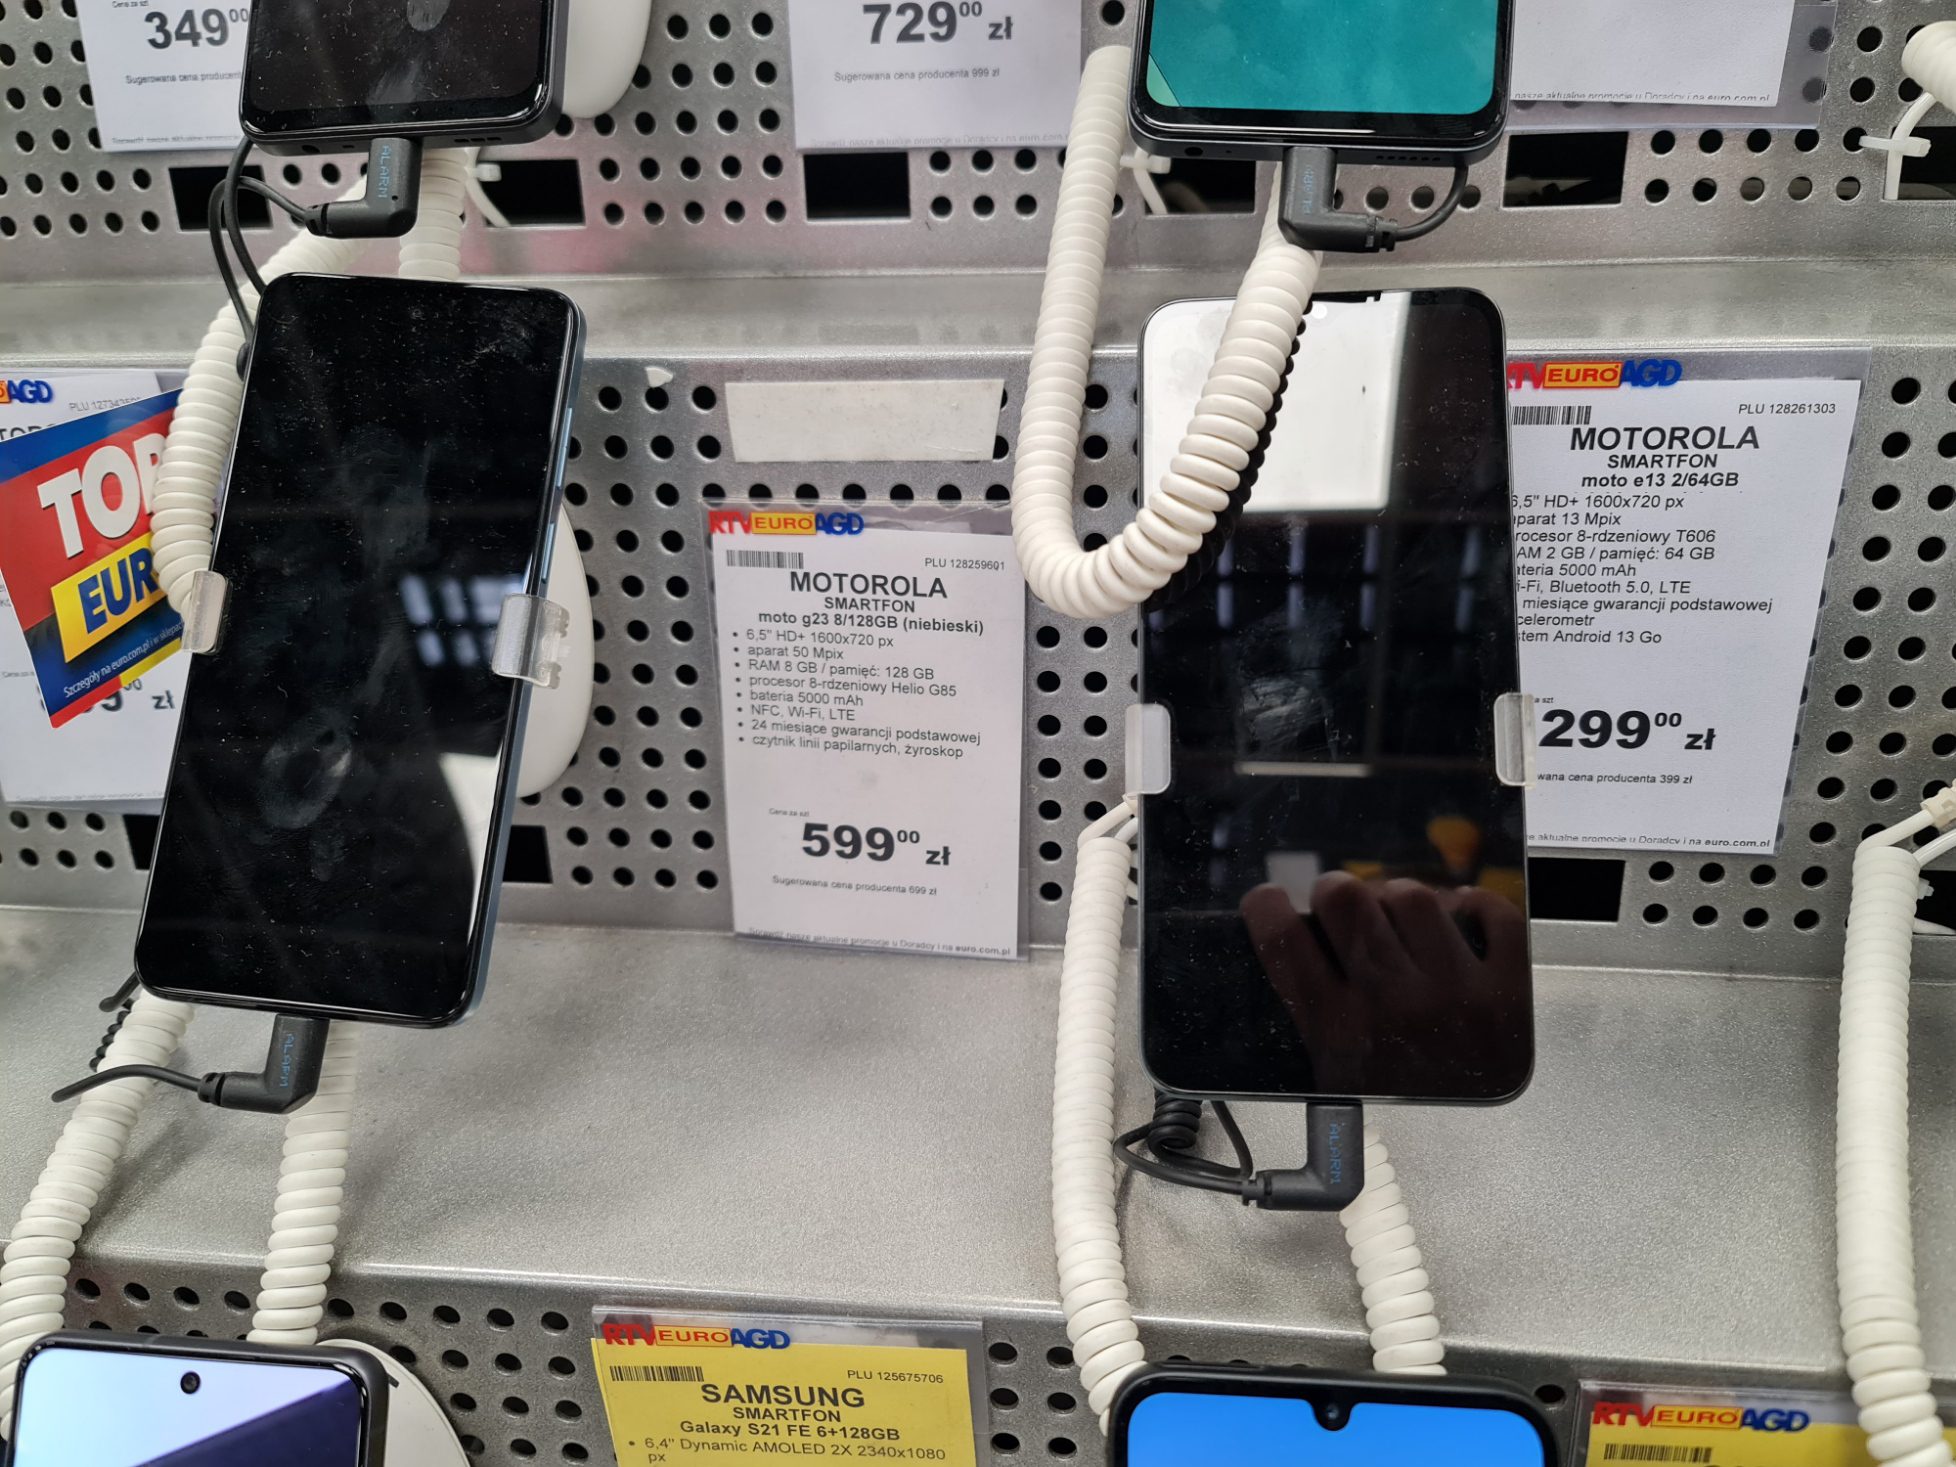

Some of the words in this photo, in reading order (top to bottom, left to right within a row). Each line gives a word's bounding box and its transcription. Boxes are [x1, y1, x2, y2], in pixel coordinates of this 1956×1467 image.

[144, 8, 229, 50] 349
[229, 8, 249, 23] 00
[862, 1, 957, 45] 729
[958, 1, 982, 17] 00
[988, 16, 1013, 40] zł
[834, 71, 891, 82] Sugerowana
[893, 71, 915, 80] cena
[918, 68, 969, 80] producenta
[971, 68, 989, 77] 999
[378, 145, 391, 198] ALARM
[1548, 367, 1619, 382] EURO
[1622, 359, 1682, 388] AGD
[8, 379, 53, 403] AGD
[1738, 403, 1765, 414] PLU
[1769, 403, 1836, 414] 128261303
[1570, 426, 1760, 451] MOTOROLA
[1607, 453, 1718, 469] SMARTFON
[1581, 473, 1628, 488] moto
[1633, 472, 1665, 487] e13
[1671, 472, 1739, 487] 2/64GB
[1544, 495, 1579, 508] HD+
[1585, 495, 1661, 508] 1600x720
[1665, 497, 1684, 511] px
[708, 511, 751, 534] RTV
[754, 515, 815, 531] EURO
[815, 512, 864, 535] AGD
[1562, 512, 1579, 525] 13
[1584, 512, 1622, 528] Mpix
[1516, 531, 1573, 542] rocesor
[1577, 529, 1671, 546] 8-rdzeniowy
[1676, 529, 1716, 542] T606
[1516, 547, 1541, 559] AM
[1546, 547, 1556, 559] 2
[1561, 547, 1585, 559] GB
[1599, 546, 1660, 562] pamięć:
[1665, 547, 1684, 560] 64
[1690, 547, 1715, 560] GB
[925, 557, 946, 568] PLU
[950, 558, 1005, 570] 128259601
[1517, 563, 1554, 576] teria
[1559, 563, 1597, 576] 5000
[1601, 564, 1636, 576] mAh
[78, 548, 159, 634] EUR
[790, 571, 948, 598] MOTOROLA
[1550, 580, 1621, 593] Bluetooth
[1625, 581, 1653, 595] 5.0,
[1659, 581, 1691, 593] LTE
[824, 597, 915, 612] SMARTFON
[1522, 597, 1589, 612] miesiące
[1593, 598, 1666, 613] gwarancji
[1670, 598, 1773, 614] podstawowej
[759, 612, 797, 624] moto
[802, 613, 829, 627] g23
[834, 613, 898, 628] 8/128GB
[903, 617, 984, 636] (niebieski)
[1517, 613, 1595, 626] celerometr
[746, 629, 772, 642] 6,5"
[776, 630, 805, 642] HD+
[811, 631, 874, 646] 1600x720
[878, 636, 894, 648] px
[1553, 630, 1612, 643] Android
[1617, 631, 1635, 643] 13
[1640, 631, 1662, 643] Go
[748, 646, 789, 657] aparat
[793, 647, 809, 658] 50
[813, 648, 844, 661] Mpix
[749, 659, 780, 671] RAM
[785, 661, 793, 672] 8
[797, 662, 818, 673] GB
[830, 664, 880, 680] pamięć:
[885, 666, 909, 679] 128
[913, 668, 934, 680] GB
[750, 677, 806, 688] procesor
[809, 677, 887, 695] 8-rdzeniowy
[891, 682, 924, 695] Helio
[929, 684, 957, 697] G85
[151, 690, 175, 709] zł
[750, 690, 794, 702] bateria
[798, 692, 830, 705] 5000
[833, 694, 864, 706] mAh
[751, 704, 784, 718] NFC,
[788, 706, 825, 720] Wi-Fi,
[829, 708, 856, 721] LTE
[752, 719, 767, 731] 24
[771, 720, 827, 736] miesiące
[831, 726, 892, 740] gwarancji
[896, 729, 981, 747] podstawowej
[1538, 708, 1651, 749] 299
[1654, 712, 1682, 728] 00
[1684, 728, 1717, 750] zł
[752, 735, 796, 748] czytnik
[799, 737, 820, 749] linii
[823, 739, 900, 756] papilarnych,
[904, 743, 964, 760] żyroskop
[1568, 774, 1594, 782] cena
[1596, 773, 1656, 784] producenta
[1659, 774, 1680, 784] 399
[1682, 775, 1693, 784] zł
[801, 821, 896, 862] 599
[896, 829, 921, 844] 00
[925, 846, 951, 866] zł
[771, 875, 828, 888] Sugerowana
[830, 881, 853, 890] cena
[855, 881, 907, 893] producenta
[602, 1323, 656, 1346] RTV
[658, 1329, 730, 1343] EURO
[731, 1328, 791, 1349] AGD
[847, 1369, 873, 1380] PLU
[877, 1372, 944, 1384] 125675706
[701, 1383, 865, 1408] SAMSUNG
[733, 1406, 841, 1423] SMARTFON
[1592, 1402, 1654, 1427] RTV
[1655, 1409, 1740, 1426] EURO
[1741, 1408, 1811, 1433] AGD
[680, 1420, 741, 1436] Galaxy
[748, 1423, 780, 1436] S21
[787, 1424, 812, 1438] FE
[817, 1425, 900, 1441] 6+128GB
[644, 1438, 675, 1450] 6,4"
[680, 1438, 748, 1453] Dynamic
[752, 1441, 826, 1455] AMOLED
[831, 1444, 852, 1456] 2X
[857, 1445, 946, 1460] 2340x1080
[648, 1453, 666, 1464] px
